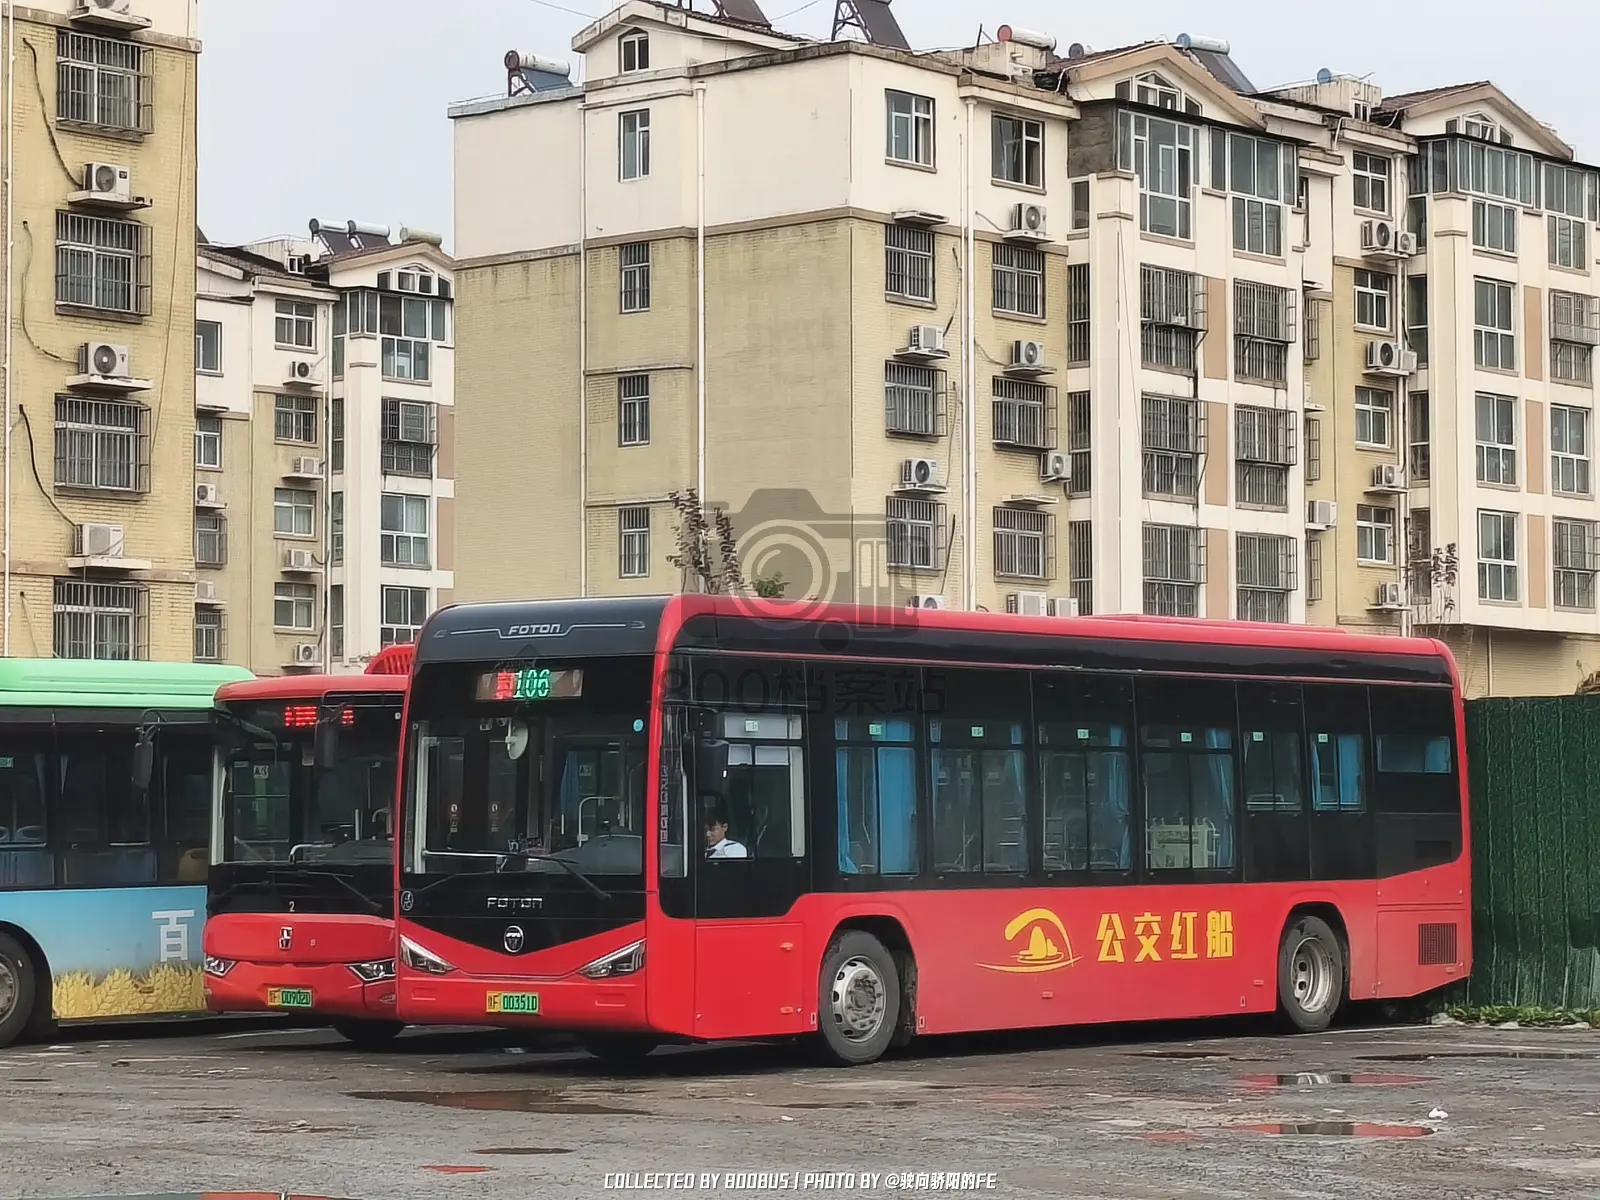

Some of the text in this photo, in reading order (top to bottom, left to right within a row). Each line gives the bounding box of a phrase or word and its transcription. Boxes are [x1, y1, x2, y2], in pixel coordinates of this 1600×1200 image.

[508, 623, 561, 636] FOTON
[487, 897, 543, 909] FOTON
[151, 909, 195, 962] 百
[1096, 910, 1234, 963] 公交红船
